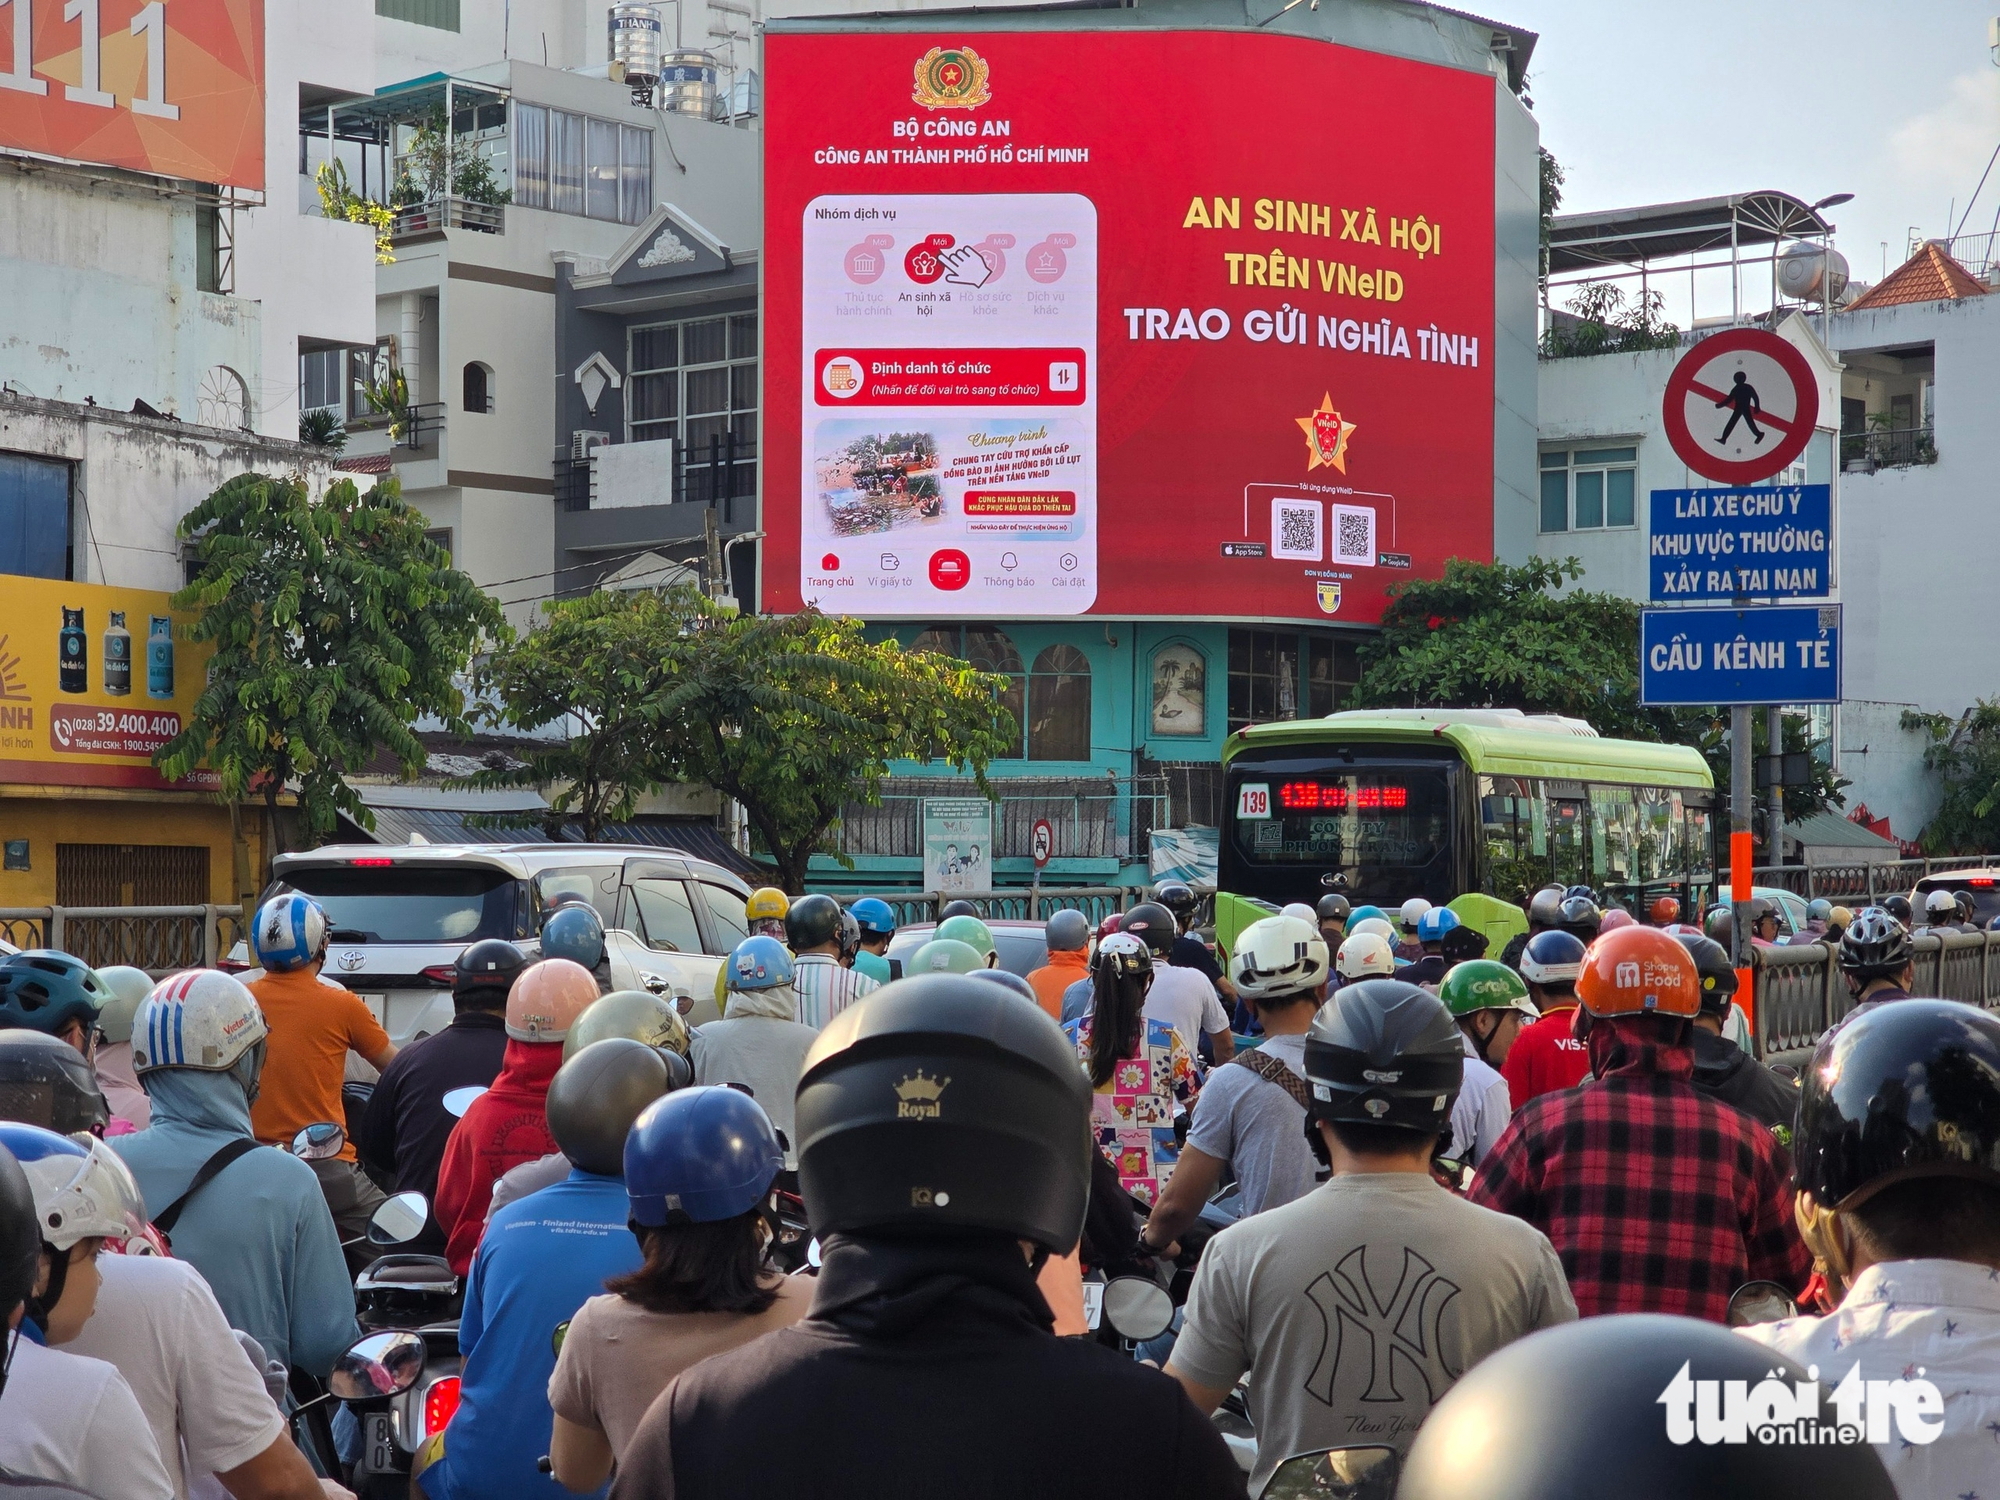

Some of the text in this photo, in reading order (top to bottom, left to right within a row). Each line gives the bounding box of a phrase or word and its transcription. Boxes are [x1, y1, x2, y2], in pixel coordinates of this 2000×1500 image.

[618, 17, 653, 30] THÀNH
[893, 117, 1010, 141] BỘ CÔNG AN
[814, 143, 1089, 164] CÔNG AN THÀNH PHỐ HỒ CHÍ MINH
[815, 208, 896, 222] Nhóm dịch vụ
[1182, 196, 1440, 260] AN SINH XÃ HỘI
[872, 237, 888, 247] Mới
[932, 237, 948, 247] Mới
[993, 237, 1008, 247] Mới
[1054, 236, 1069, 246] Mới
[1224, 248, 1404, 303] TRÊN VNeID
[844, 290, 884, 305] Thủ tục
[898, 291, 951, 302] An sinh xã
[959, 290, 1012, 302] Hồ sơ sức
[1027, 291, 1065, 304] Dịch vụ
[836, 303, 892, 316] hành chính
[917, 304, 933, 317] hội
[1033, 303, 1058, 315] khác
[1124, 303, 1478, 367] TRAO GỬI NGHĨA TÌNH
[872, 360, 991, 376] Định danh tổ chức
[872, 383, 1040, 398] (Nhấn để đổi vai trò sang tổ chức)
[1317, 418, 1338, 429] VNeID
[968, 425, 1048, 448] Chương trình
[952, 442, 1070, 466] CHUNG TAY CỨU TRỢ KHẨN CẤP
[943, 454, 1081, 479] ĐỒNG BÀO BỊ ẢNH HƯỞNG BỞI LŨ LỤT
[967, 469, 1050, 487] TRÊN NỀN TẢNG VNeID
[1299, 482, 1308, 490] Tải
[1309, 483, 1321, 493] ứng
[1321, 485, 1336, 494] dụng
[1675, 487, 1802, 518] LÁI XE CHÚ Ý
[1651, 524, 1824, 561] KHU VỰC THƯỜNG
[806, 575, 854, 590] Trang chủ
[868, 575, 913, 590] Ví giấy tờ
[984, 576, 1035, 589] Thông báo
[1052, 576, 1086, 589] Cài đặt
[1663, 563, 1817, 596] XẢY RA TAI NẠN
[1650, 629, 1830, 672] CẦU KÊNH TẺ
[0, 706, 33, 730] NH
[72, 712, 179, 737] (028) 39.400.400
[15, 736, 34, 749] hơn
[75, 738, 169, 752] Tổng đài CSKH: 1900.5454
[187, 771, 197, 783] Số
[1242, 791, 1267, 814] 139
[1362, 821, 1386, 834] TY
[1285, 839, 1355, 853] PHƯƠN
[1643, 961, 1680, 973] Shopee
[1472, 979, 1510, 994] Grab
[1644, 973, 1681, 987] Food
[897, 1101, 941, 1121] Royal
[504, 1220, 536, 1231] Vietnam
[542, 1219, 576, 1228] Finland
[1344, 1415, 1420, 1441] New Yor
